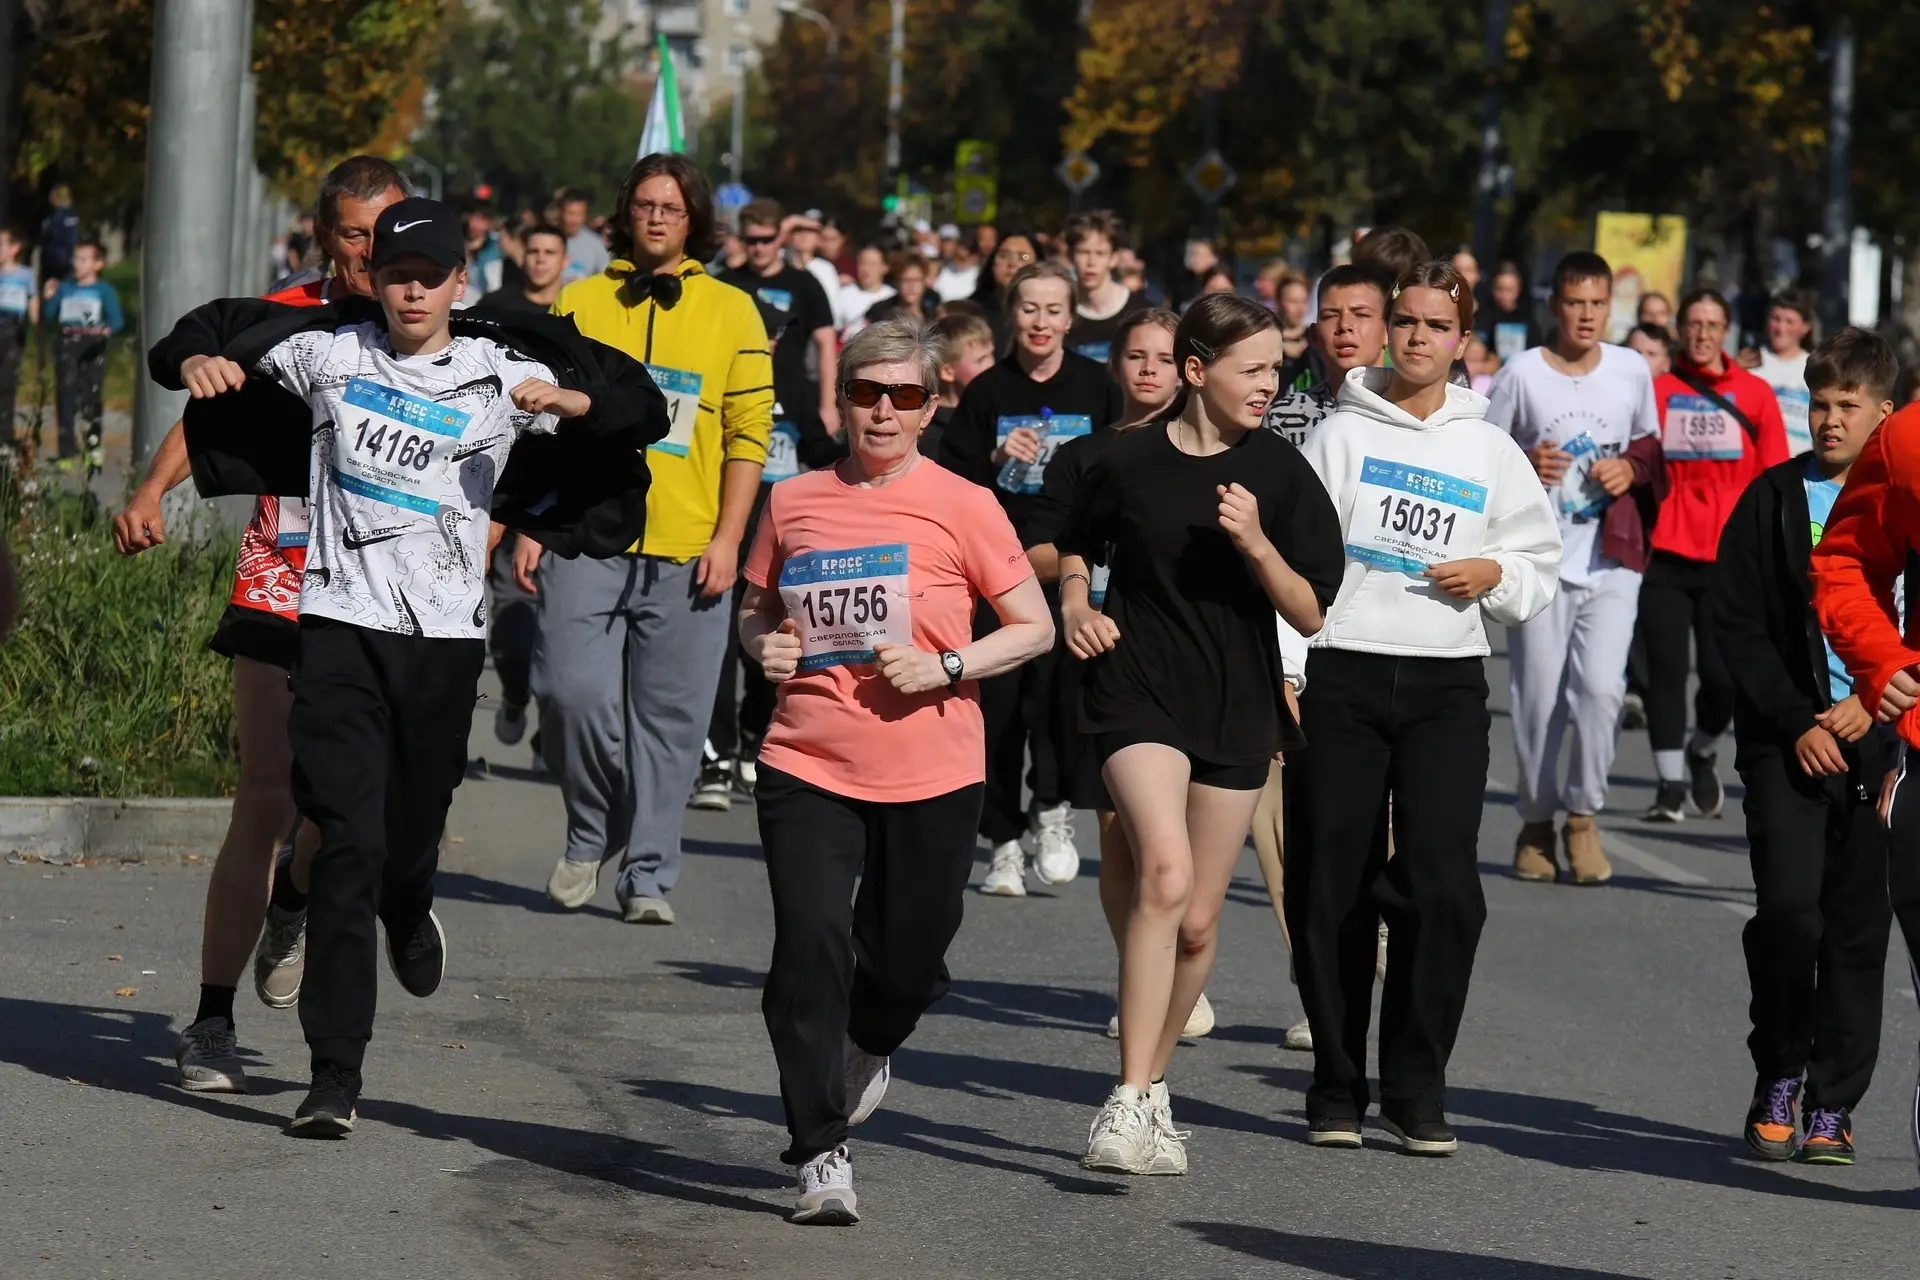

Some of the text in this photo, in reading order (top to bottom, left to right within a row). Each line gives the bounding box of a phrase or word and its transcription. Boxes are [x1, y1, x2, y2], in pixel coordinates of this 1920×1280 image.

[387, 406, 424, 423] НАЦИИ
[389, 395, 428, 417] КРОСС
[669, 398, 680, 424] 1
[354, 417, 435, 471] 14168
[767, 439, 784, 460] 21
[346, 457, 421, 485] СВЕРДЛОВСКАЯ
[361, 471, 397, 486] ОБЛАСТЬ
[1407, 472, 1445, 491] КРОСС
[1406, 482, 1443, 496] НАЦИИ
[1379, 494, 1457, 545] 15031
[1374, 535, 1447, 559] СВЕРДЛОВСКАЯ
[821, 556, 863, 571] КРОСС
[821, 567, 863, 576] НАЦИИ
[802, 584, 888, 628] 15756
[809, 629, 887, 643] СВЕРДЛОВСКАЯ
